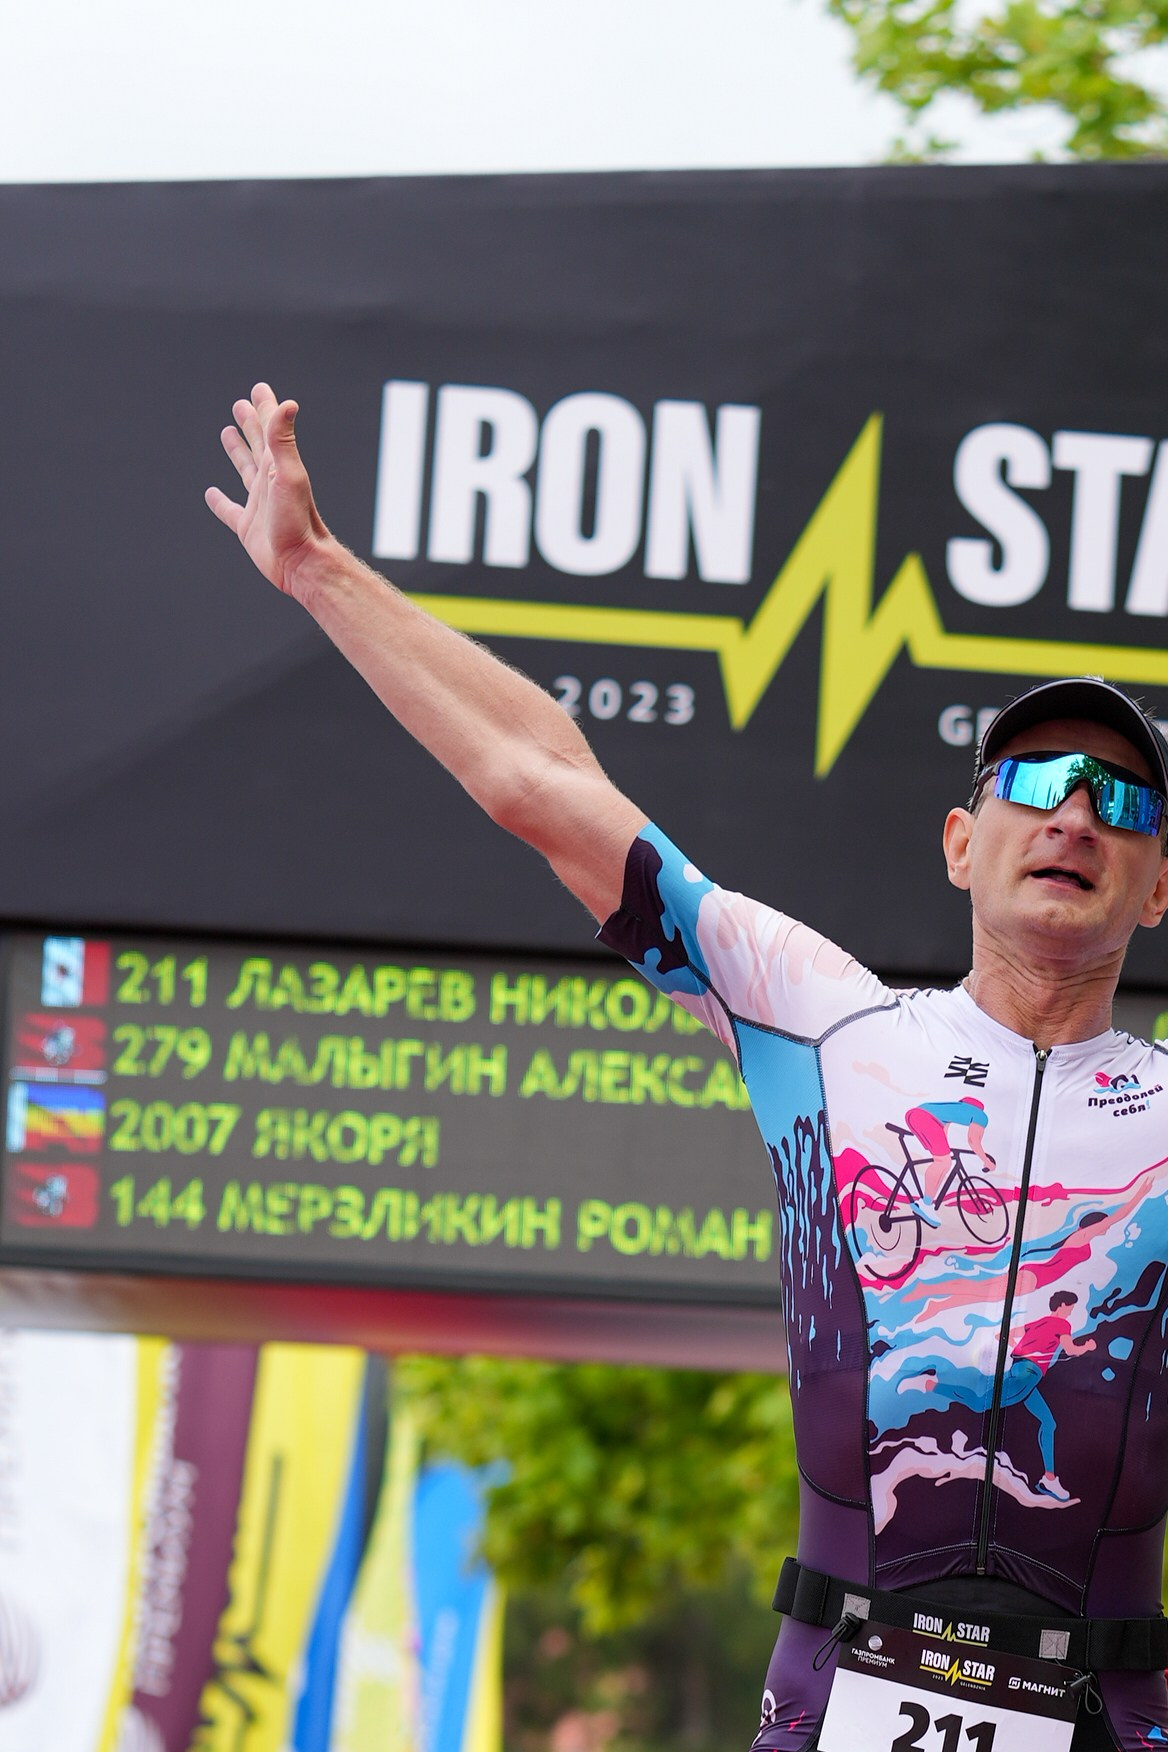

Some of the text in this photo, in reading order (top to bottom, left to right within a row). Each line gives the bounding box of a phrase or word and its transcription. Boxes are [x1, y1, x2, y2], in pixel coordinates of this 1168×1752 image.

[371, 380, 762, 584] IRON
[552, 674, 696, 726] 2023
[115, 950, 208, 1008] 211
[225, 957, 476, 1023] ЛАЗАРЕВ
[112, 1022, 751, 1112] 279 МАЛЫГИН АЛЕКСА
[1088, 1084, 1164, 1108] Преодолей
[108, 1098, 441, 1169] 2007 ЯКОРЯ
[109, 1173, 773, 1263] 144 МЕРЗЛИКИН РОМАН
[913, 1612, 991, 1643] IRON STAR
[851, 1648, 896, 1665] ГАЗПРОМБАНК
[857, 1656, 888, 1668] ПРЕМИУМ
[920, 1649, 996, 1681] IRON STAR
[1022, 1681, 1066, 1698] МАГНИТ
